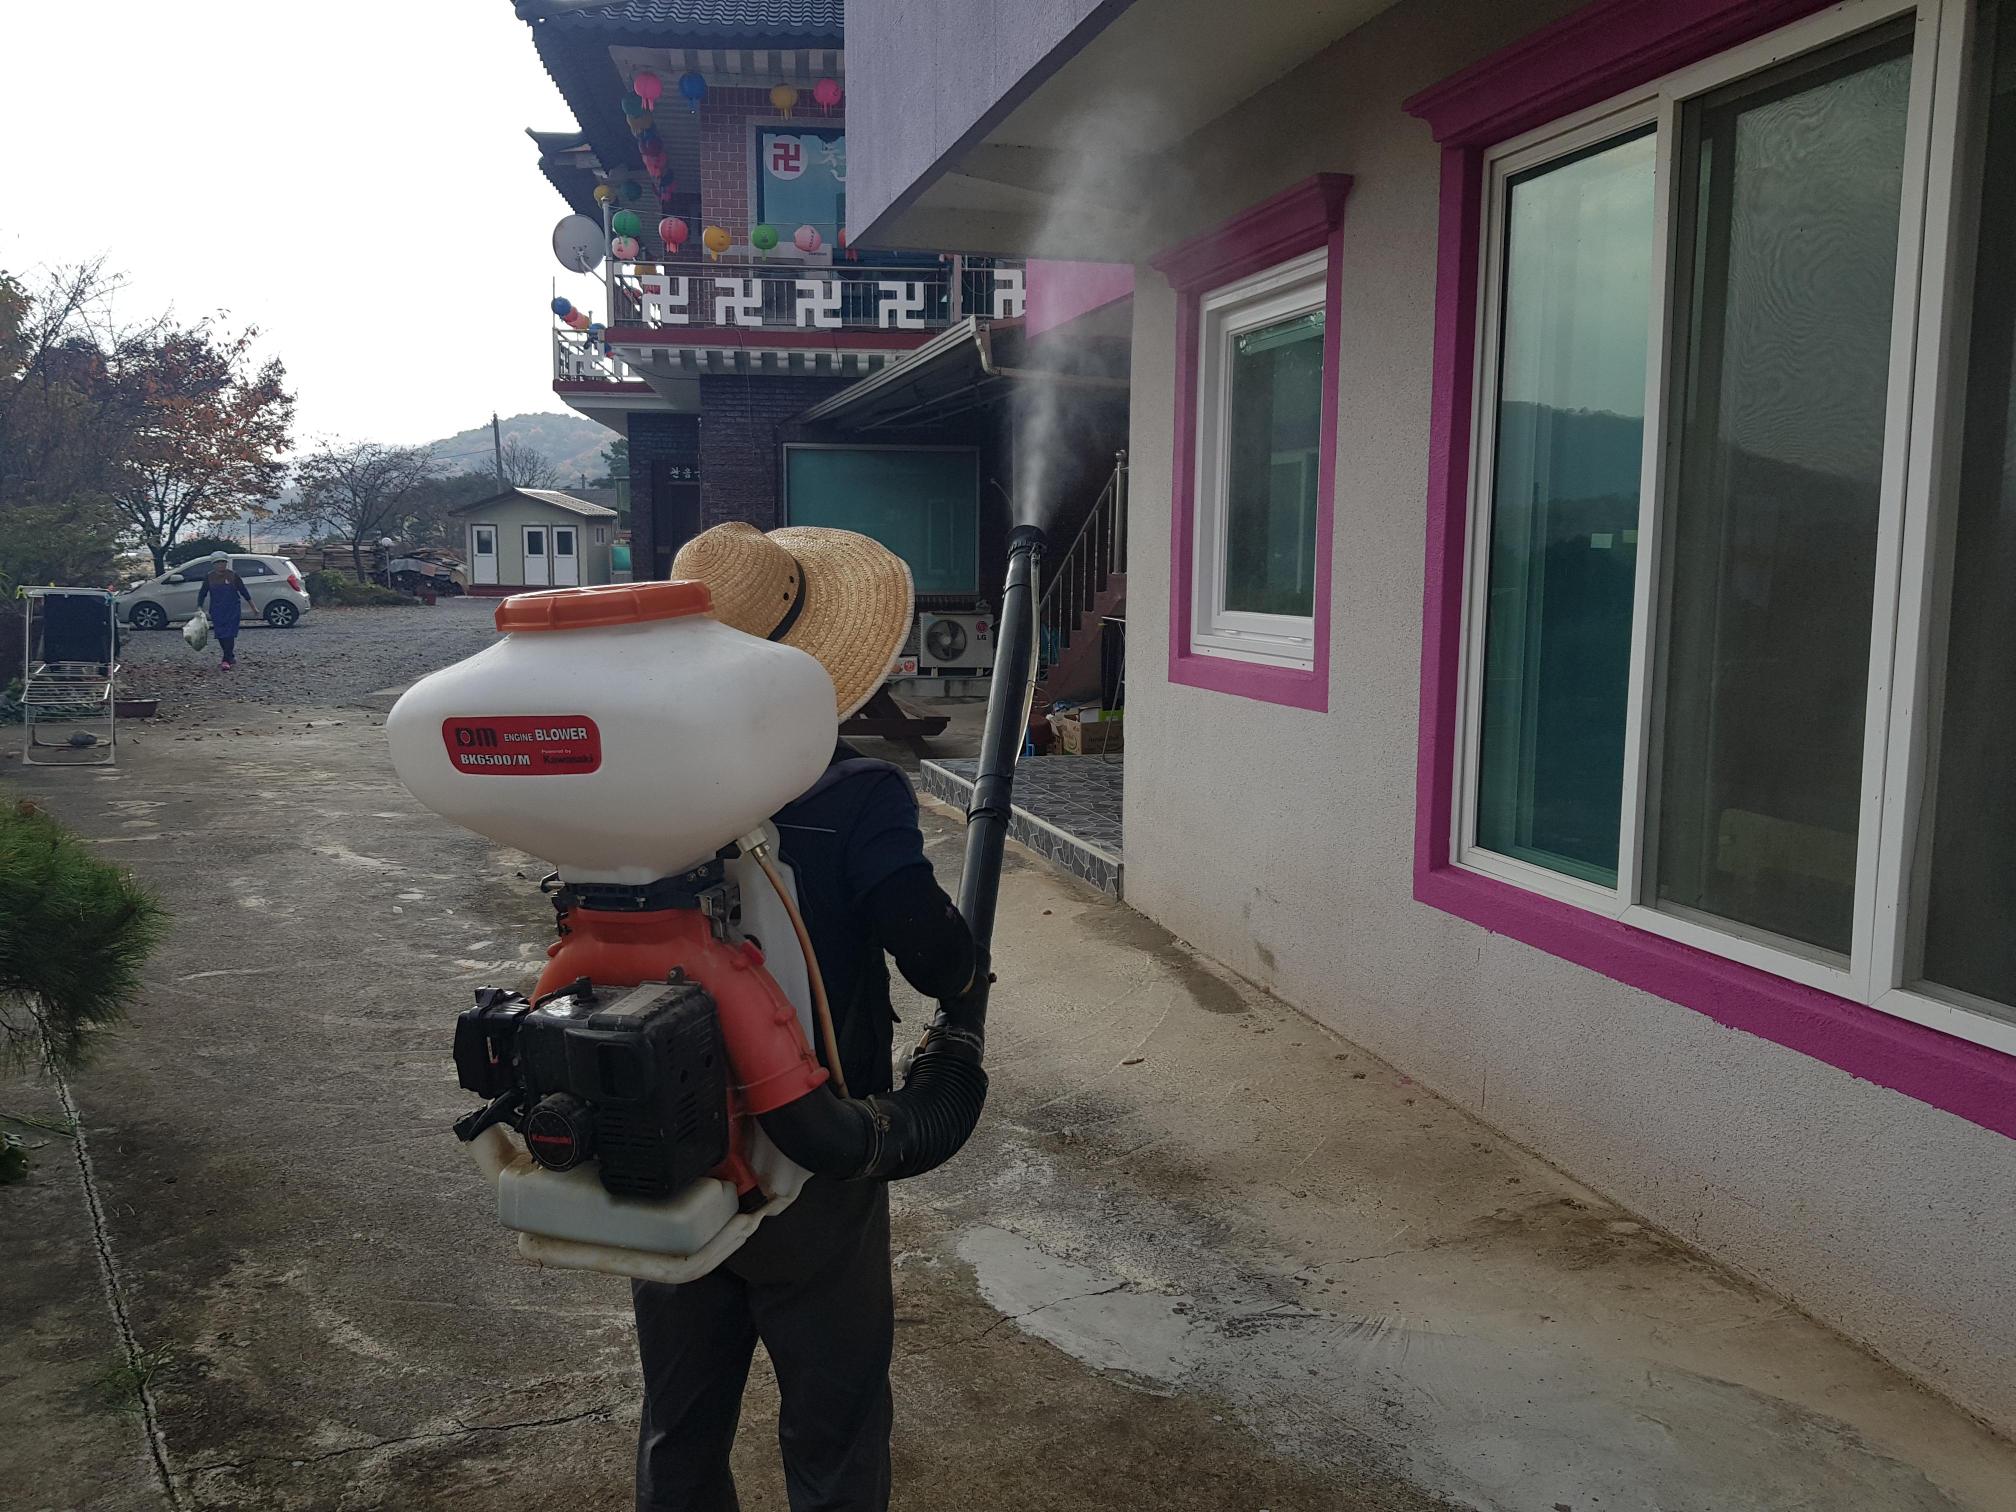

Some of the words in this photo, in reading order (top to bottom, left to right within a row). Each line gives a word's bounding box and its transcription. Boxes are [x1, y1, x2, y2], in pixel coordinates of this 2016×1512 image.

[503, 733, 534, 742] ENGINE
[535, 727, 588, 741] BLOWER
[460, 753, 531, 766] BK6500/M
